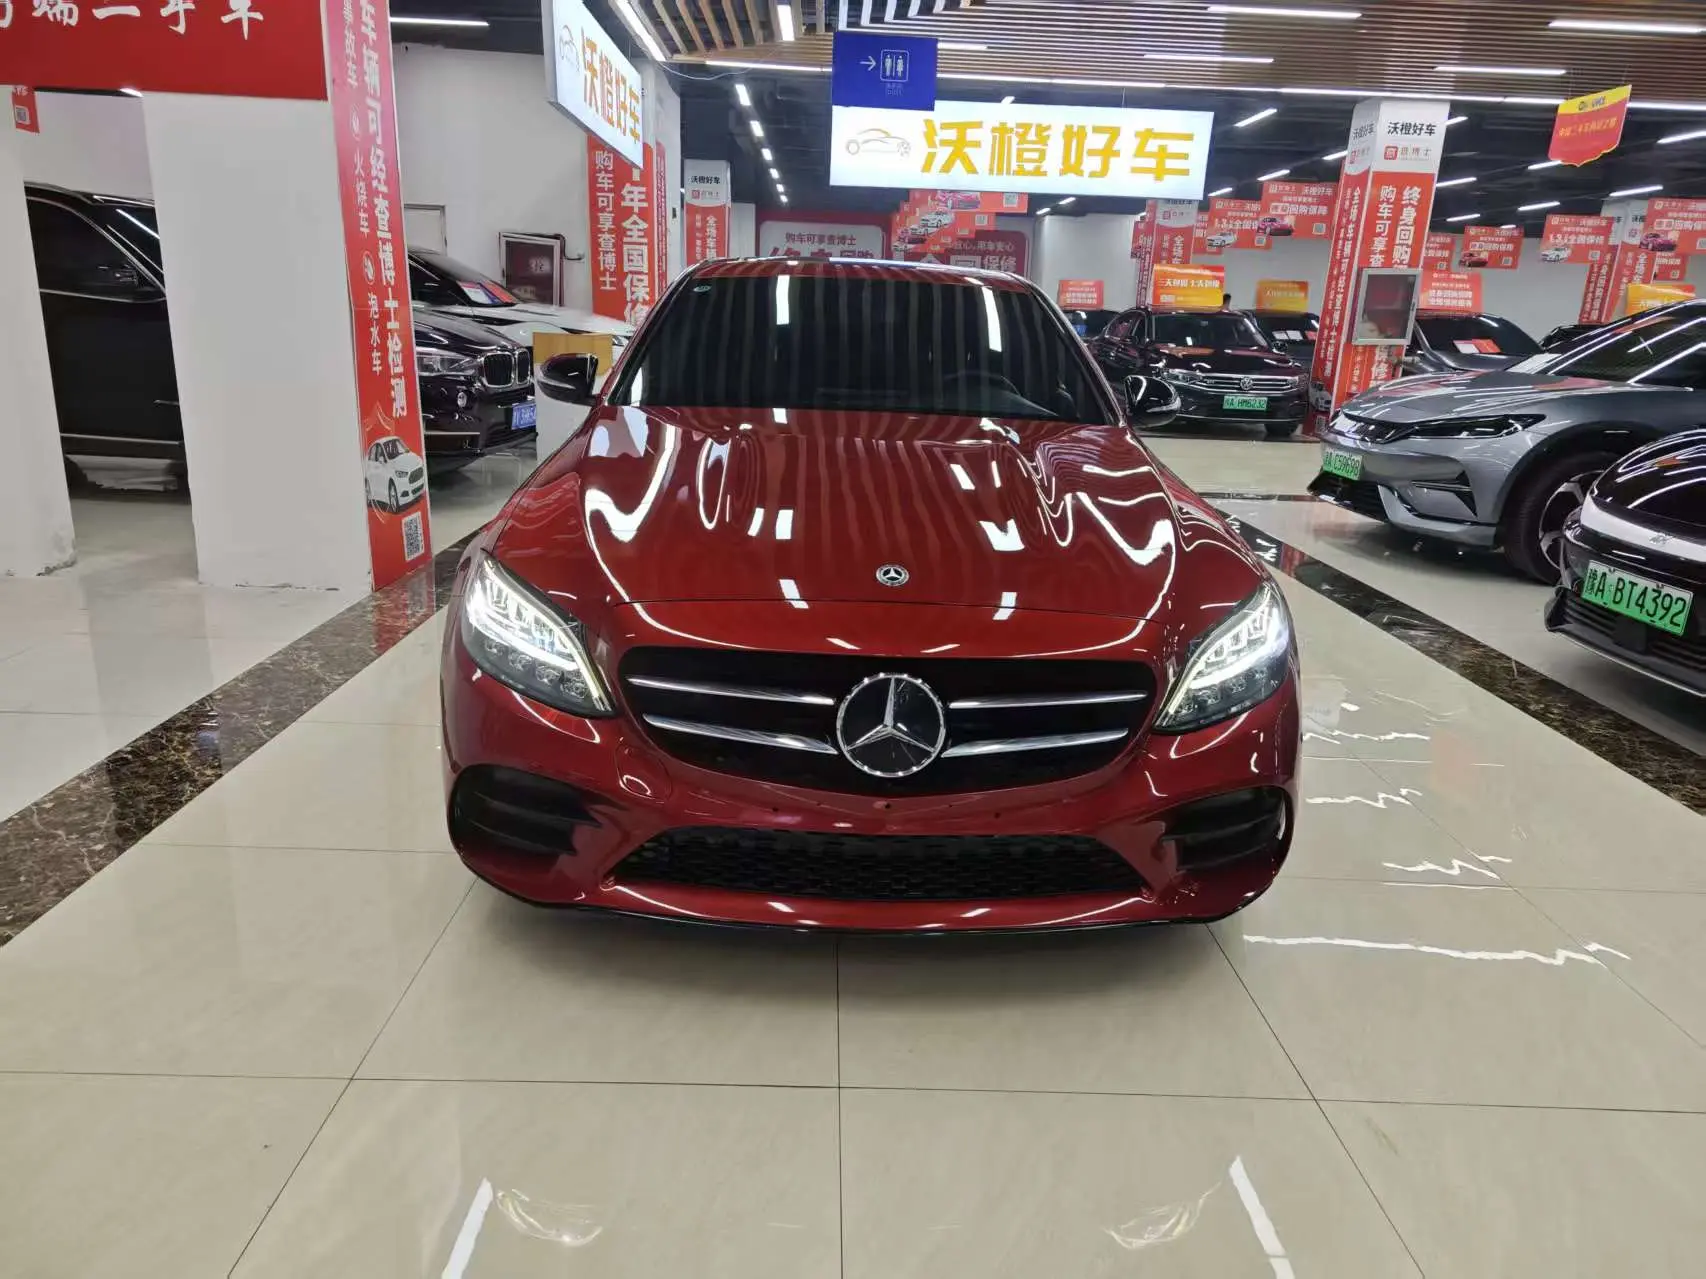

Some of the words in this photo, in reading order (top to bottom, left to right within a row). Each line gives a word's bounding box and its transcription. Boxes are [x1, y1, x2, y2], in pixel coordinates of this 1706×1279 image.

[0, 0, 263, 40] 端二手车
[581, 26, 641, 144] 沃橙好车
[920, 117, 1195, 181] 沃橙好车
[1387, 122, 1437, 136] 沃橙好车
[353, 149, 371, 237] 火烧车
[595, 150, 617, 290] 购车可享查博士
[785, 232, 857, 246] 购车可享查博士
[367, 291, 383, 375] 泡水车
